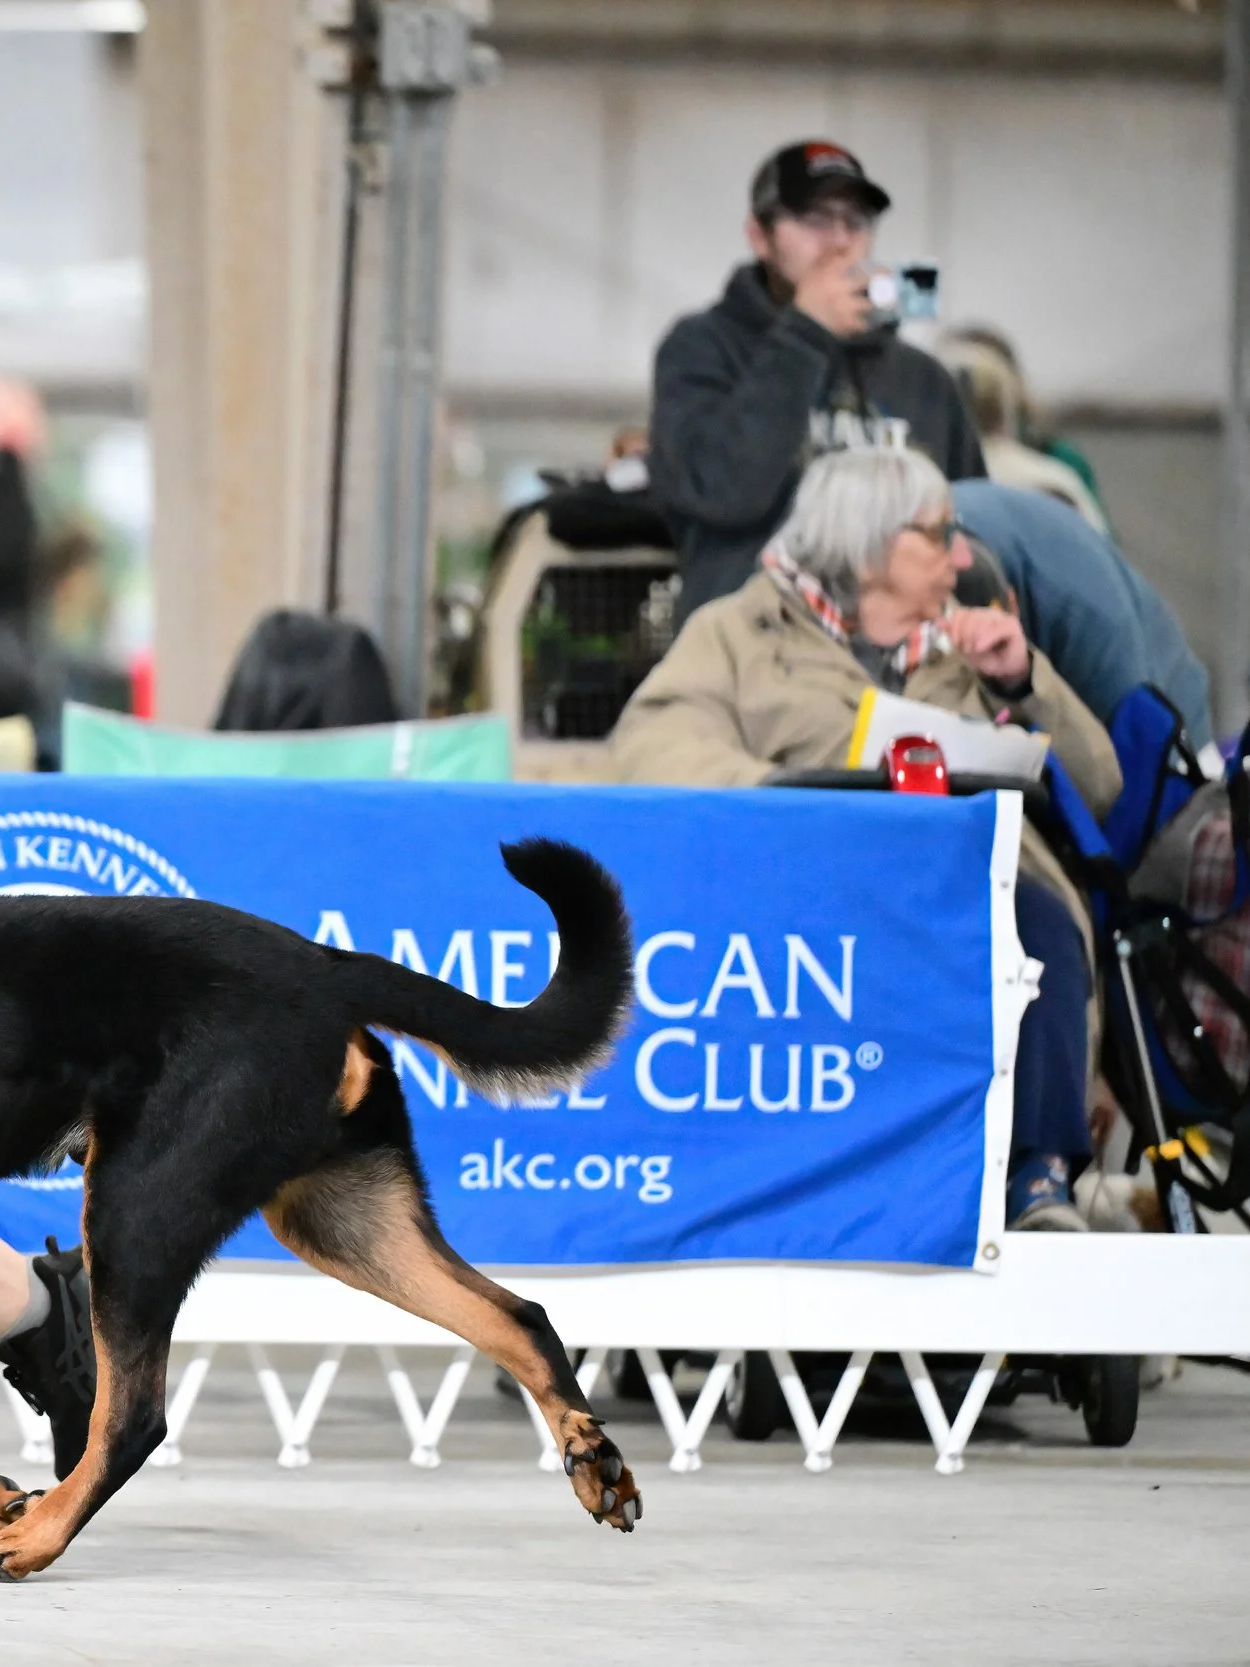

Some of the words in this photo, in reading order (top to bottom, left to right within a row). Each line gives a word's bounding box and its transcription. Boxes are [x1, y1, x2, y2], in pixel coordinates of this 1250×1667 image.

[13, 835, 171, 897] KENNE
[313, 910, 857, 1022] MECAN
[459, 1138, 674, 1204] akc.org
